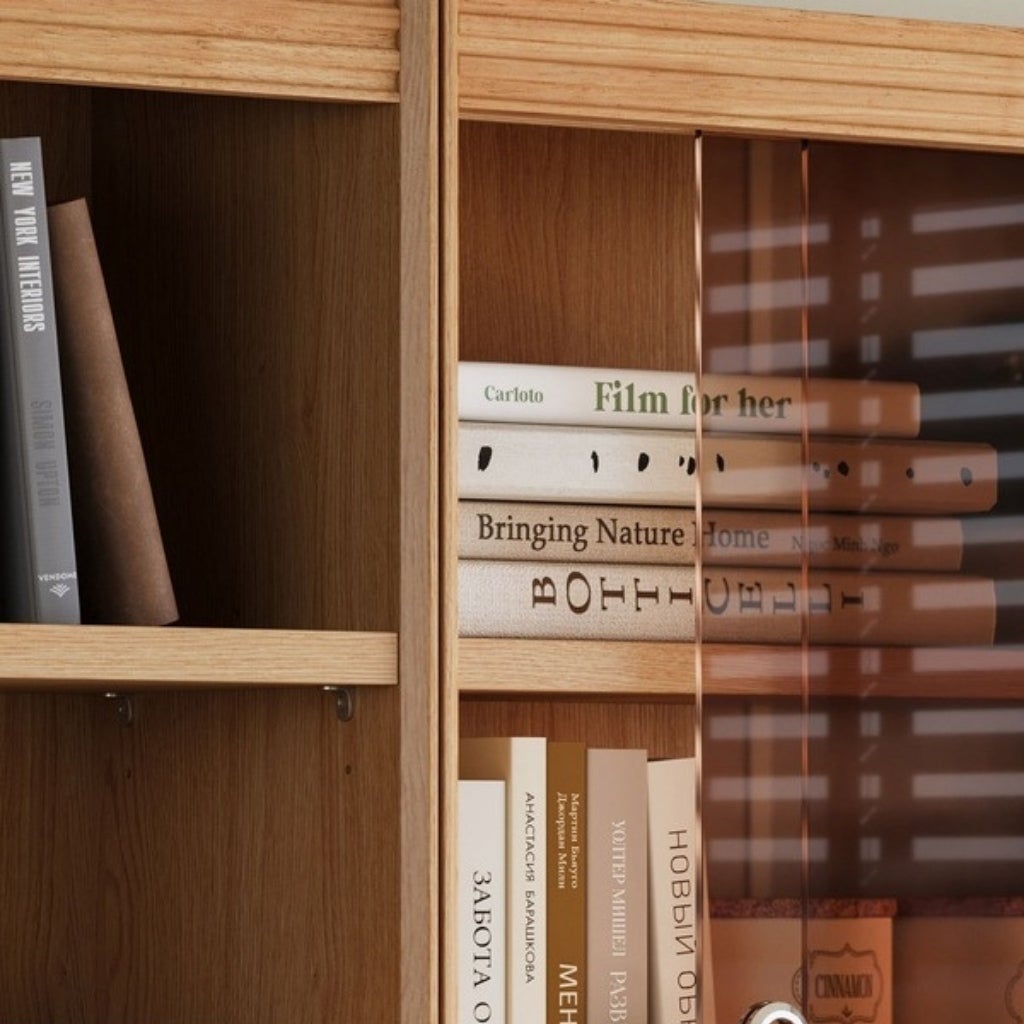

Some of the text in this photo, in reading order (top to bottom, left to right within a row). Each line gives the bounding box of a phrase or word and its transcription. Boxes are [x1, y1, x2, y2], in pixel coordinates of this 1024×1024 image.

[10, 161, 45, 333] NEW YORK INTERIORS
[484, 384, 543, 404] Carloto
[594, 381, 792, 419] Film for her
[30, 400, 60, 507] SIMON UPTON
[477, 512, 588, 551] Bringing
[596, 517, 685, 547] Nature
[692, 520, 770, 549] Home
[531, 570, 865, 616] BOTTICELLI
[556, 792, 568, 890] Джордан Милн
[570, 792, 580, 842] Мартин
[611, 819, 627, 885] УОЛТЕР
[524, 791, 536, 985] АНАСТАСИЯ БАРАШКОВА
[668, 829, 697, 957] НОВЫЙ
[472, 870, 494, 988] ЗАБОТА
[611, 887, 627, 958] МИШЕЛ
[474, 1001, 493, 1024] О
[815, 974, 873, 998] CINNAMON
